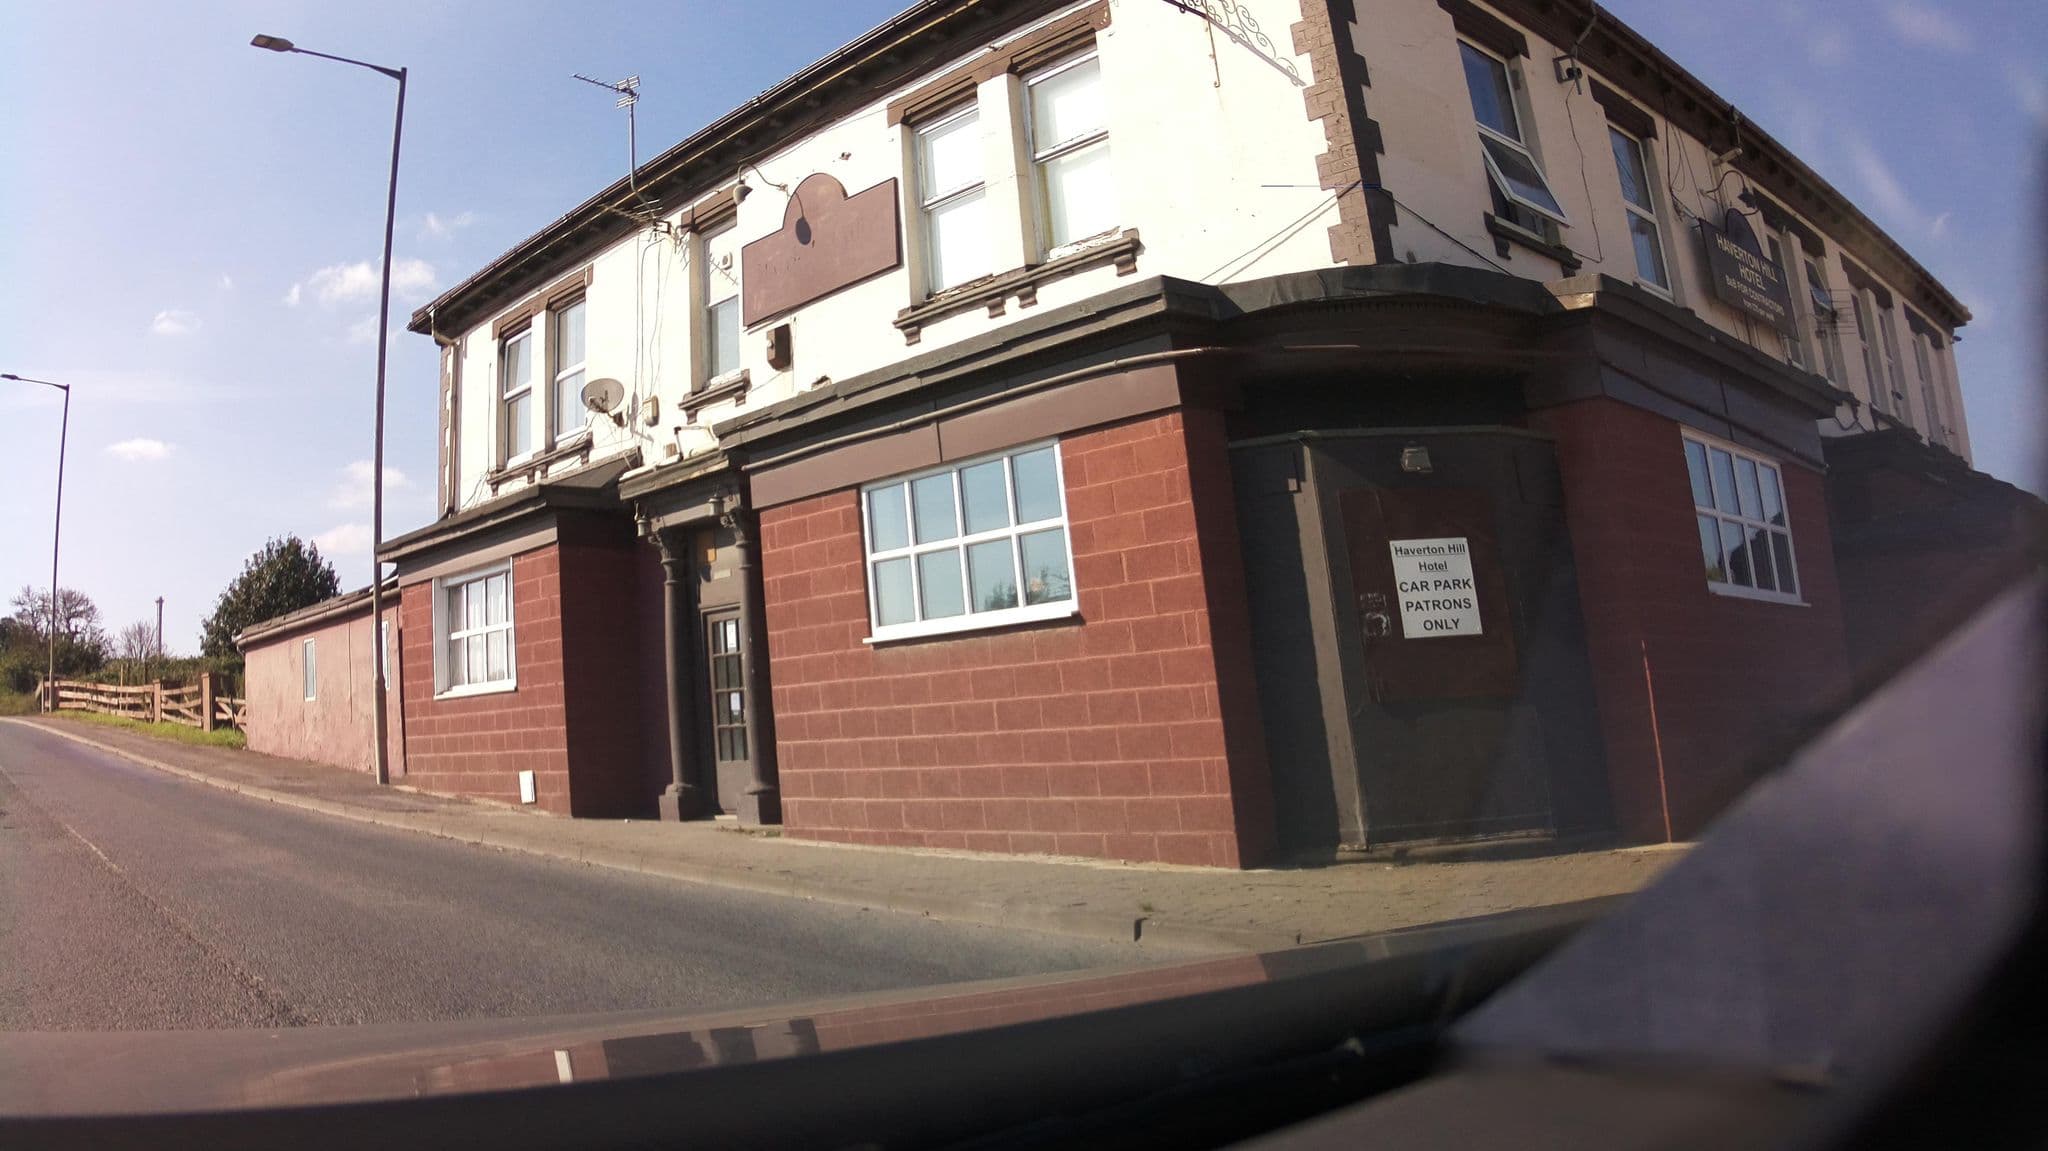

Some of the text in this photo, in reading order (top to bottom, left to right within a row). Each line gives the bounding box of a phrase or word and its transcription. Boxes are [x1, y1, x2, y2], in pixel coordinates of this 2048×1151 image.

[1715, 232, 1778, 283] HAVERTON HILL
[1738, 263, 1766, 291] HOTEL
[1394, 544, 1466, 556] Haverton Hill
[1418, 561, 1448, 571] Hotel
[1399, 578, 1472, 593] CAR PARK
[1406, 598, 1472, 612] PATRONS
[1423, 618, 1460, 631] ONLY
